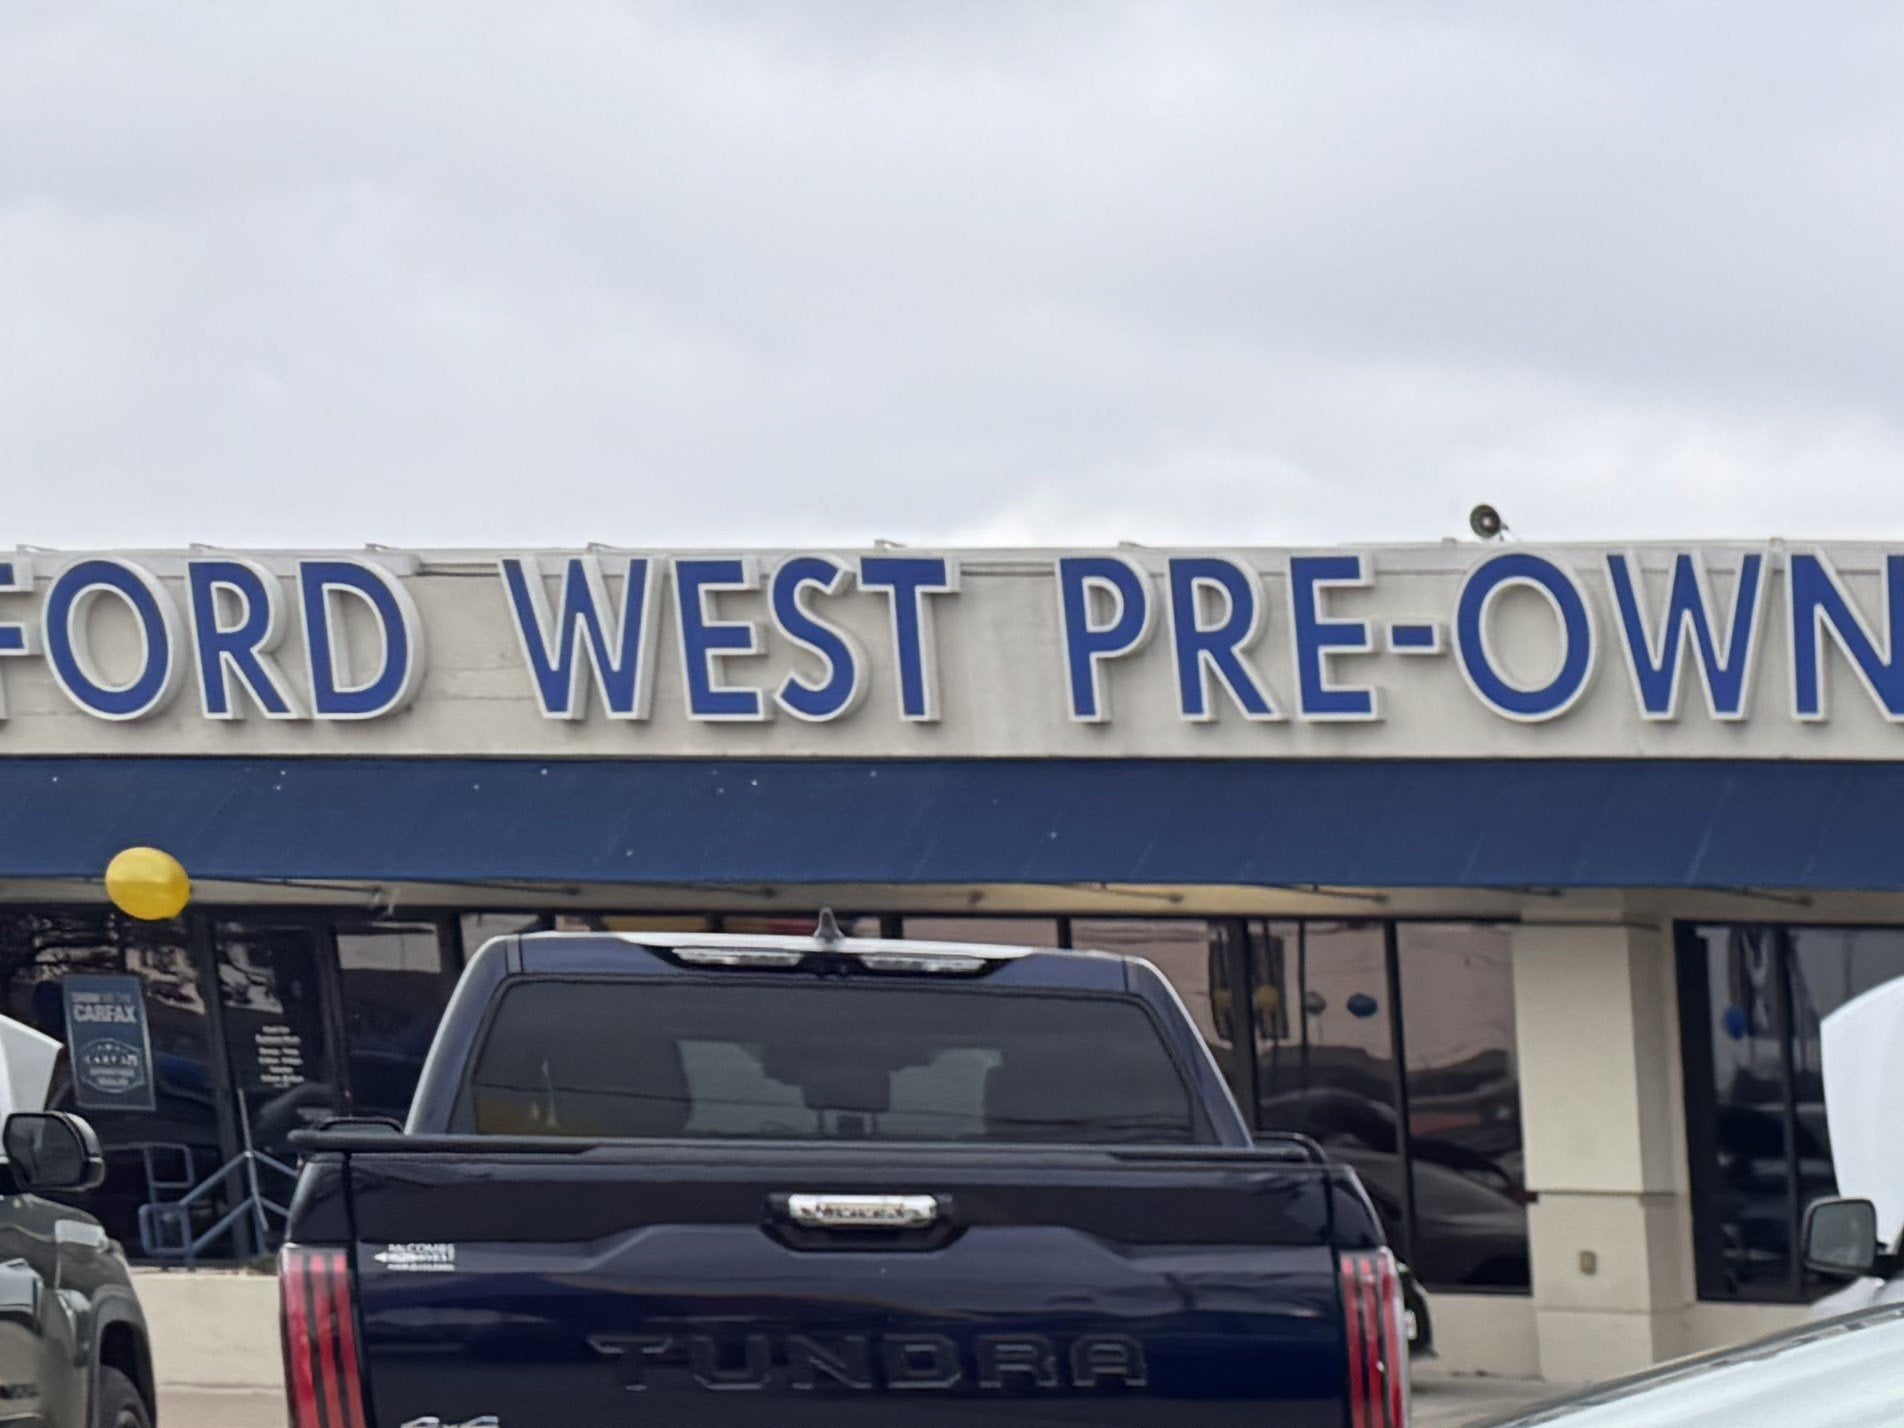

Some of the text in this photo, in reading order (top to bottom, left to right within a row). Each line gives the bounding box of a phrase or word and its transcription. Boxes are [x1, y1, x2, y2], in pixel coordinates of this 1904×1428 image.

[500, 555, 958, 722] WEST
[74, 1004, 137, 1024] CARFAX
[587, 1333, 1147, 1391] TUNDRA
